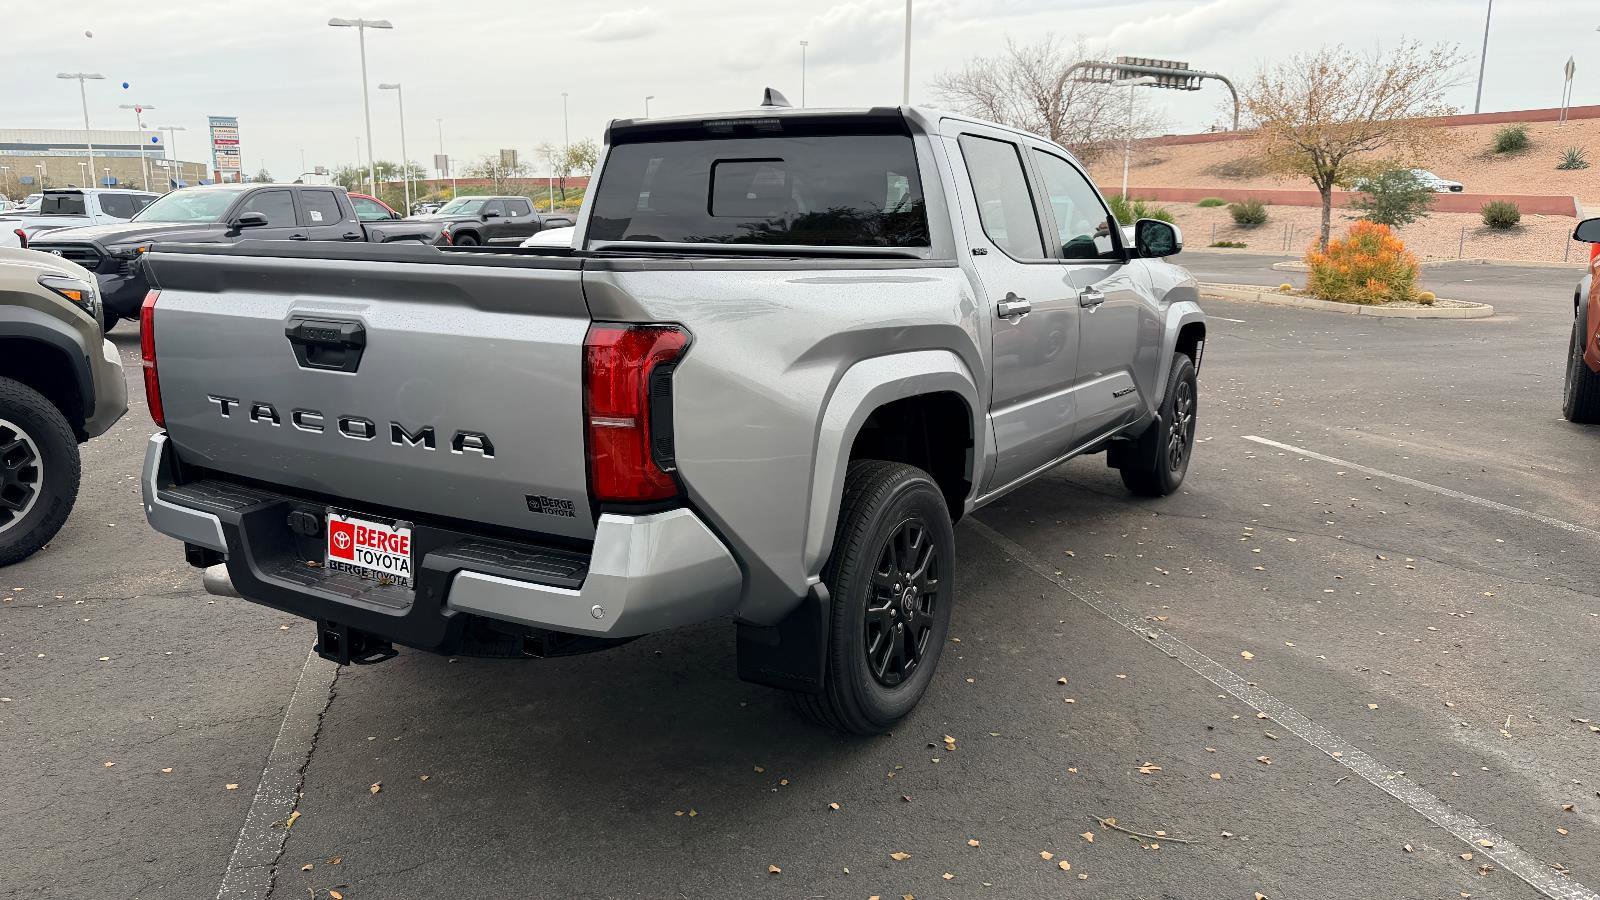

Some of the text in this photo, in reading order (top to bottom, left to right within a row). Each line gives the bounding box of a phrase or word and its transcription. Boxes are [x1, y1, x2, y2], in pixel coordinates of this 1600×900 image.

[207, 394, 495, 459] TACOMA
[541, 496, 573, 509] BERGE
[543, 508, 576, 517] TOYOTA
[356, 525, 409, 555] BERGE
[329, 560, 369, 577] BERGE
[356, 548, 410, 574] TOYOTA
